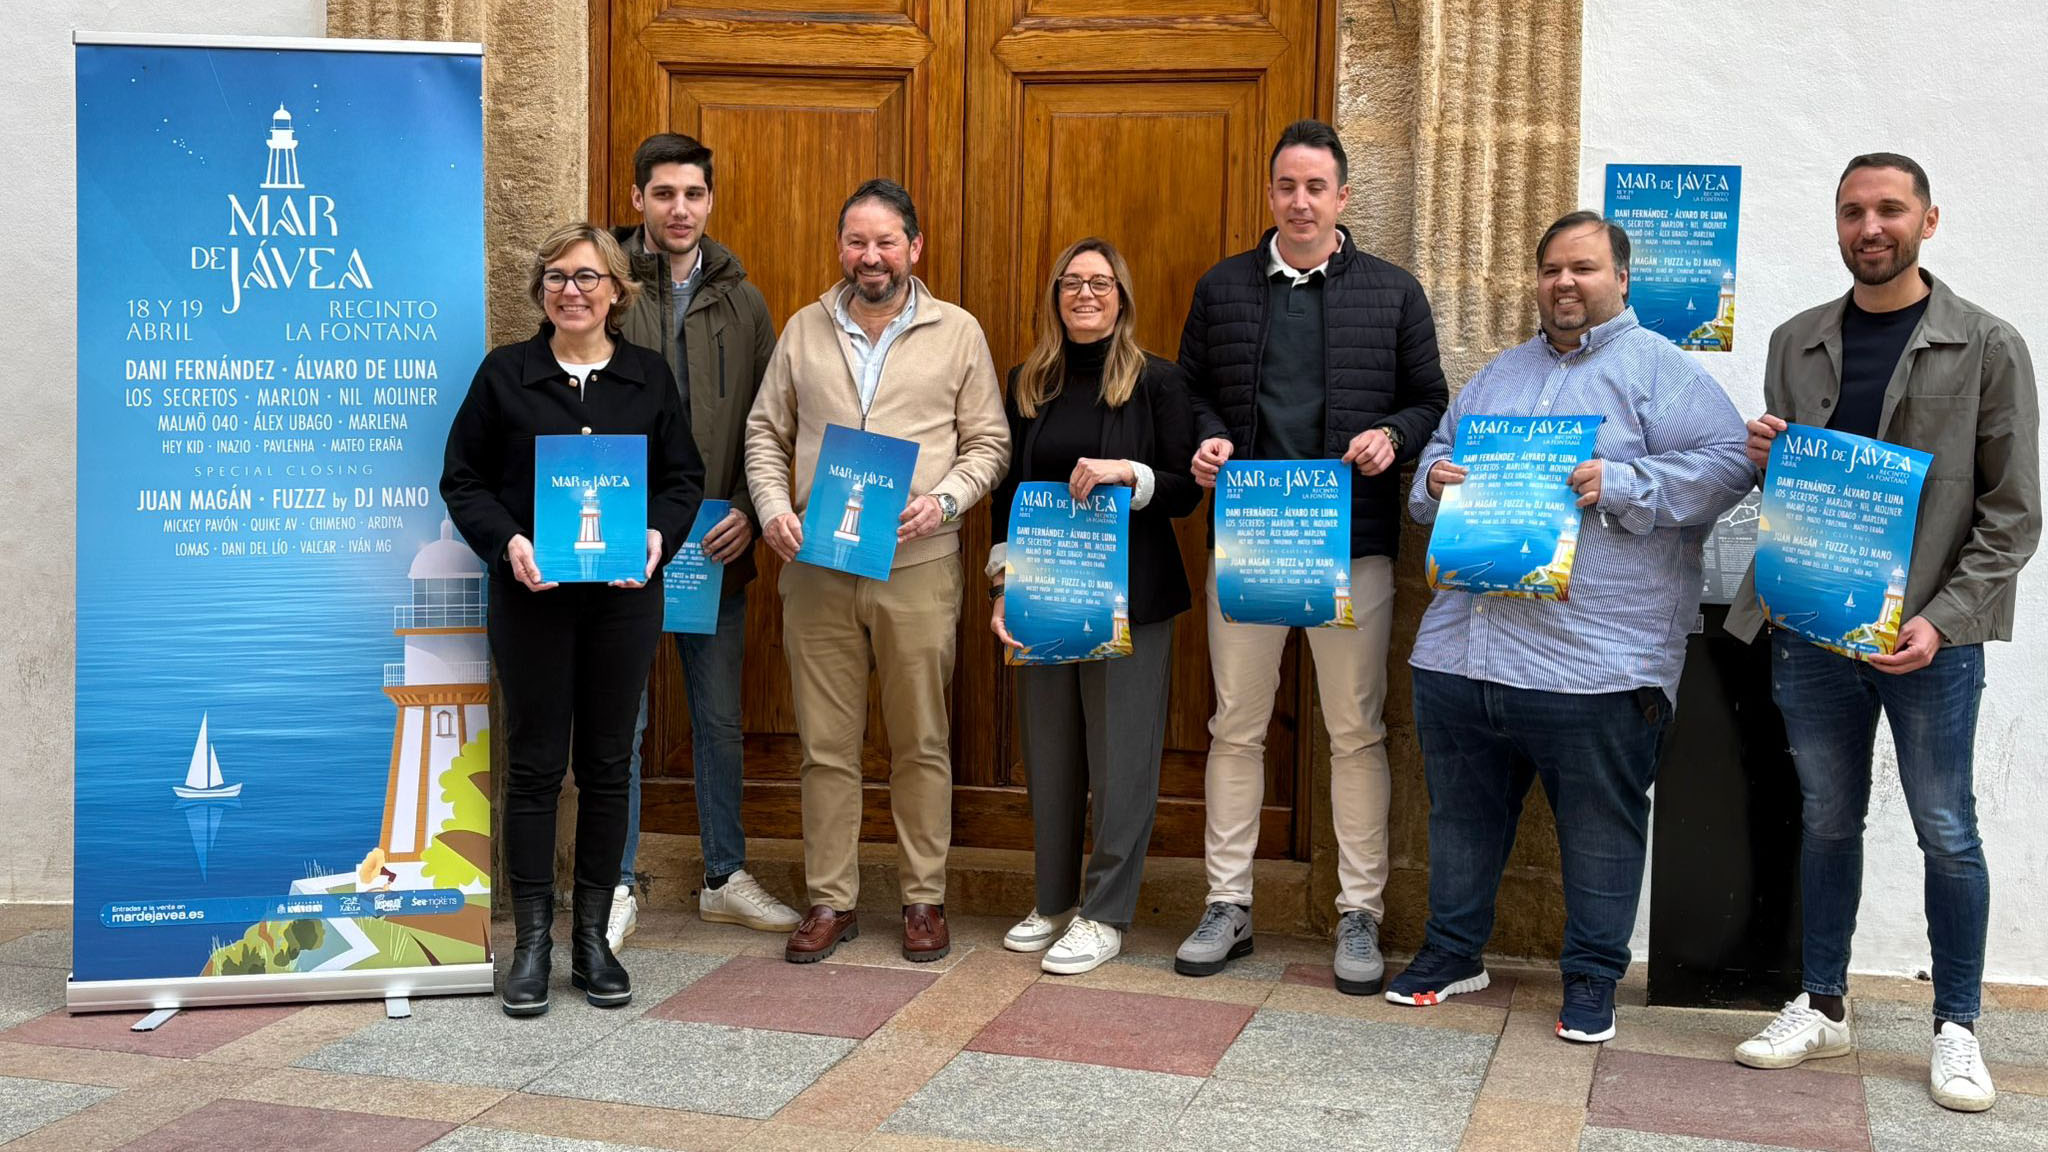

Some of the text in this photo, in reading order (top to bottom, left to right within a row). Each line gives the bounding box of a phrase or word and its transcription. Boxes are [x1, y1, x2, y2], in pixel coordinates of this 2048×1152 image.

[1616, 171, 1729, 199] MAR DE JÁVEA
[227, 194, 338, 236] MAR
[1614, 208, 1728, 220] DANI FERNÁNDEZ ÁLVARO DE LUNA
[191, 239, 374, 315] DE JÁVEA
[126, 299, 203, 318] 18 Y 19
[329, 299, 438, 319] RECINTO
[126, 322, 193, 341] ABRIL
[286, 322, 438, 341] LA FONTANA
[125, 354, 438, 380] DANI FERNÁNDEZ ÁLVARO DE LUNA
[125, 387, 438, 407] LOS SECRETOS MARLON NIL MOLINER
[158, 412, 206, 431] MALMÖ
[253, 410, 284, 431] ÁLEX
[289, 414, 333, 431] UBAGO
[348, 413, 408, 430] MARLENA
[1468, 419, 1583, 442] MAR DE JÁVEA
[162, 436, 403, 454] HEY KID INAZIO PAVLENHA MATEO ERAÑA
[1784, 434, 1911, 473] MAR DE JÁVEA
[1462, 451, 1577, 463] DANI FERNÁNDEZ ÁLVARO DE LUNA
[194, 464, 373, 477] SPECIAL CLOSING
[828, 464, 852, 479] MAR
[551, 475, 580, 488] MAR
[1226, 466, 1338, 497] MAR DE JÁVEA
[1776, 476, 1904, 506] DANI FERNÁNDEZ ÁLVARO DE LUNA
[136, 483, 429, 512] JUAN MAGÁN FUZZZ by DJ NANO
[1021, 490, 1053, 508] MAR
[1056, 499, 1069, 509] DE
[1225, 506, 1338, 517] DANI FERNÁNDEZ ÁLVARO DE LUNA
[163, 515, 403, 533] MICKEY PAVÓN QUIKE AV CHIMENO ARDIYA
[1017, 526, 1117, 543] DANI FERNÁNDEZ ÁLVARO DE LUNA
[175, 536, 392, 556] LOMAS DANI DEL LÍO VALCAR IVÁN MG
[1793, 535, 1818, 548] MAGÁN
[1825, 540, 1848, 553] FUZZZ
[1859, 546, 1870, 557] DJ
[1871, 549, 1892, 561] NANO
[112, 910, 204, 923] mardejavea.es
